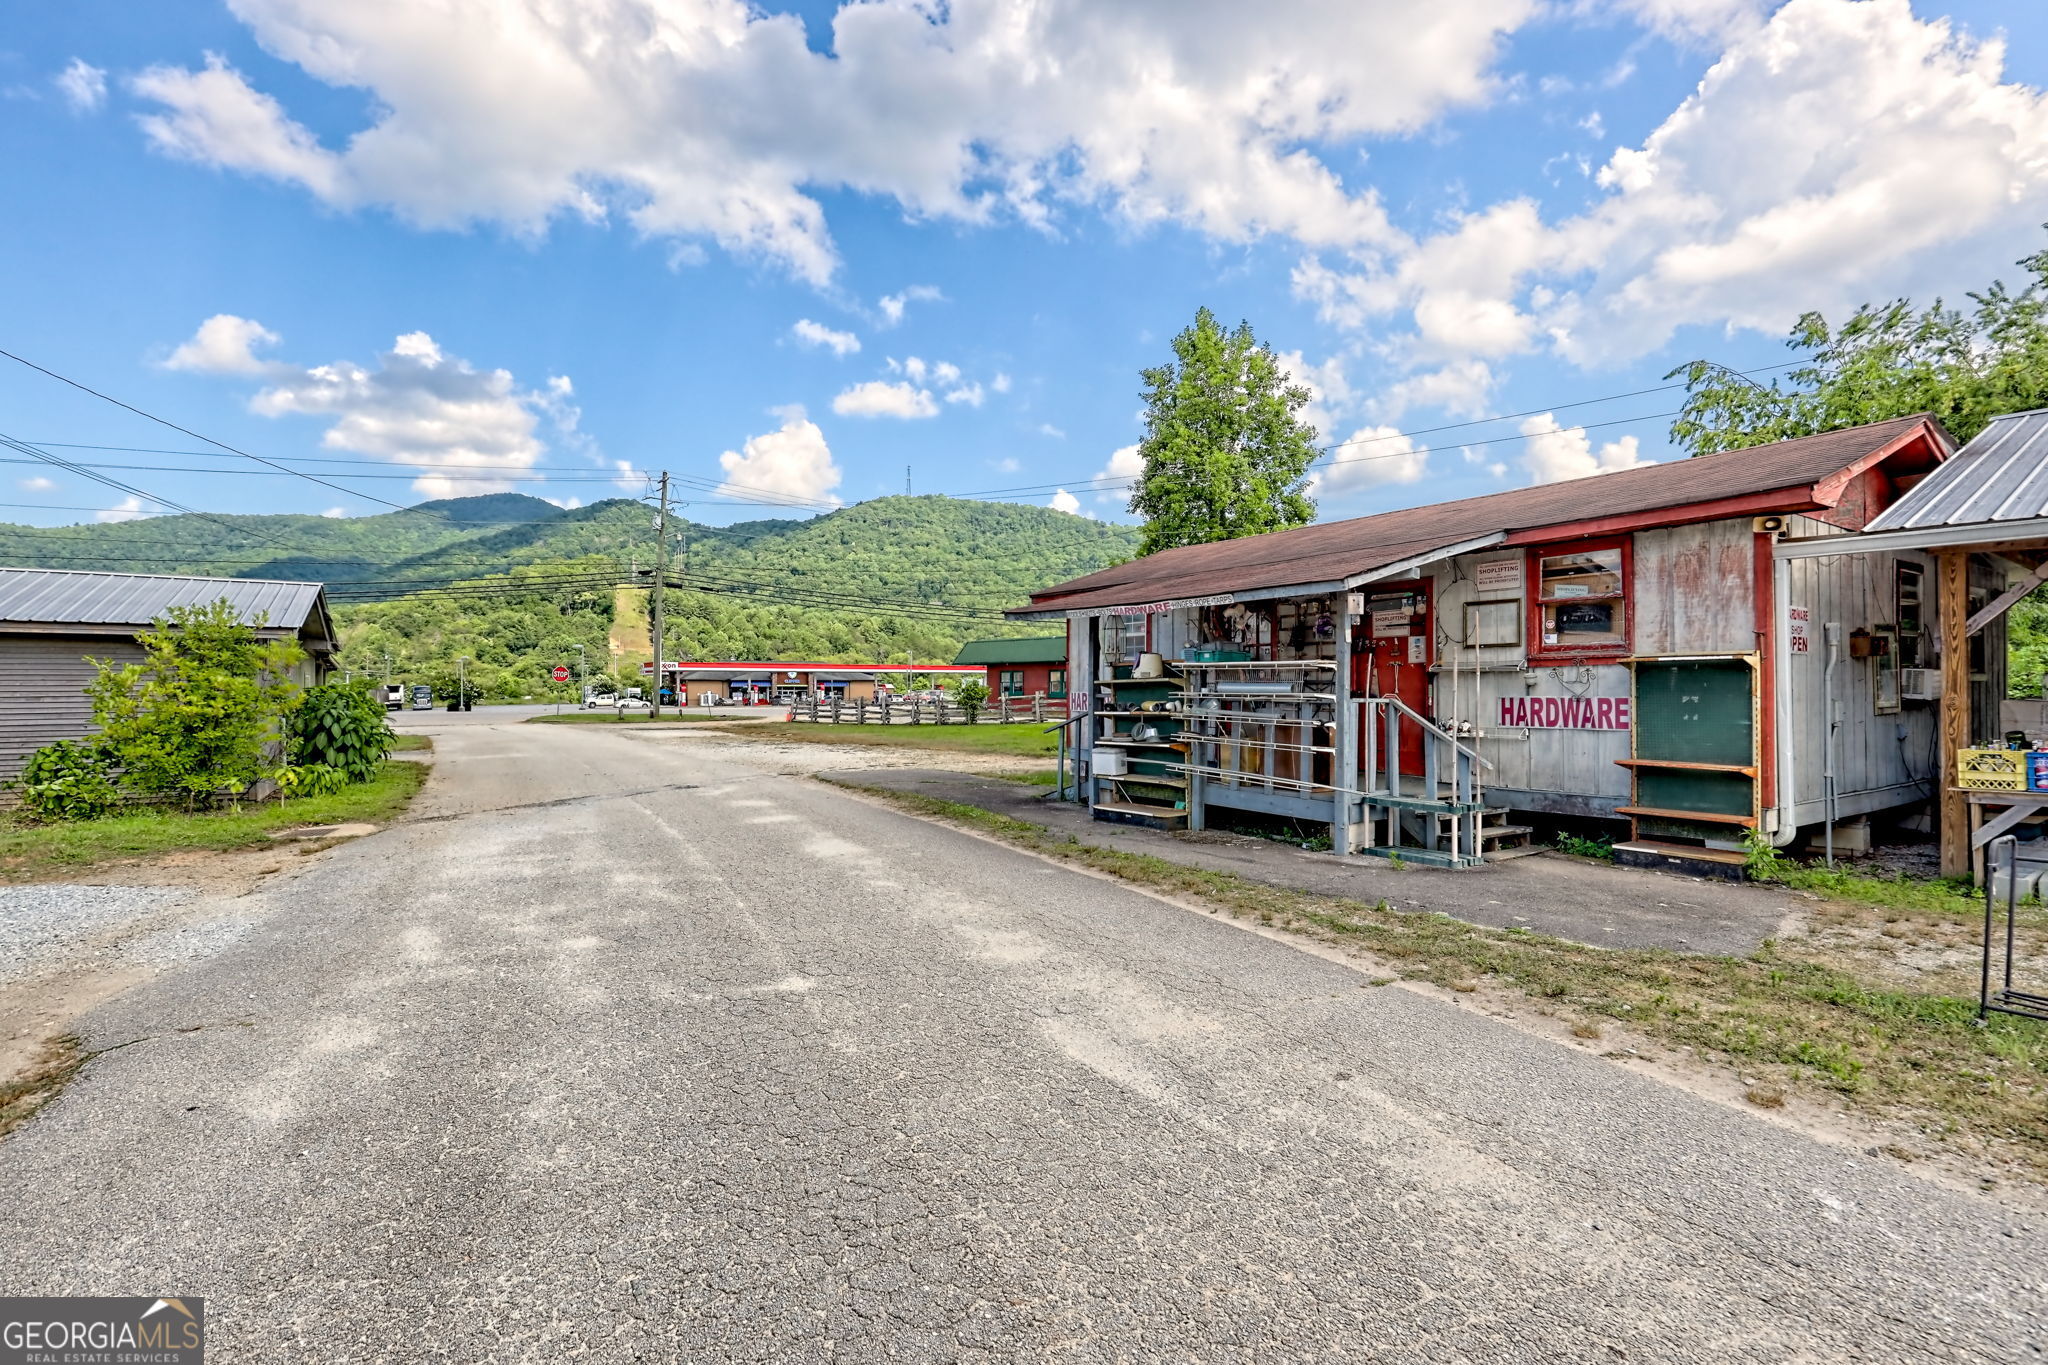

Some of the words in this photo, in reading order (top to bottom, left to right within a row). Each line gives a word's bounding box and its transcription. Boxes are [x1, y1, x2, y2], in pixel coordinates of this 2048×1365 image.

[1479, 566, 1519, 574] SHOPLIFTING
[1113, 602, 1170, 615] HARDWARE
[1195, 598, 1210, 606] ROPE
[1213, 595, 1232, 603] TARPS
[1791, 636, 1808, 651] PEN
[1501, 697, 1629, 729] HARDWARE
